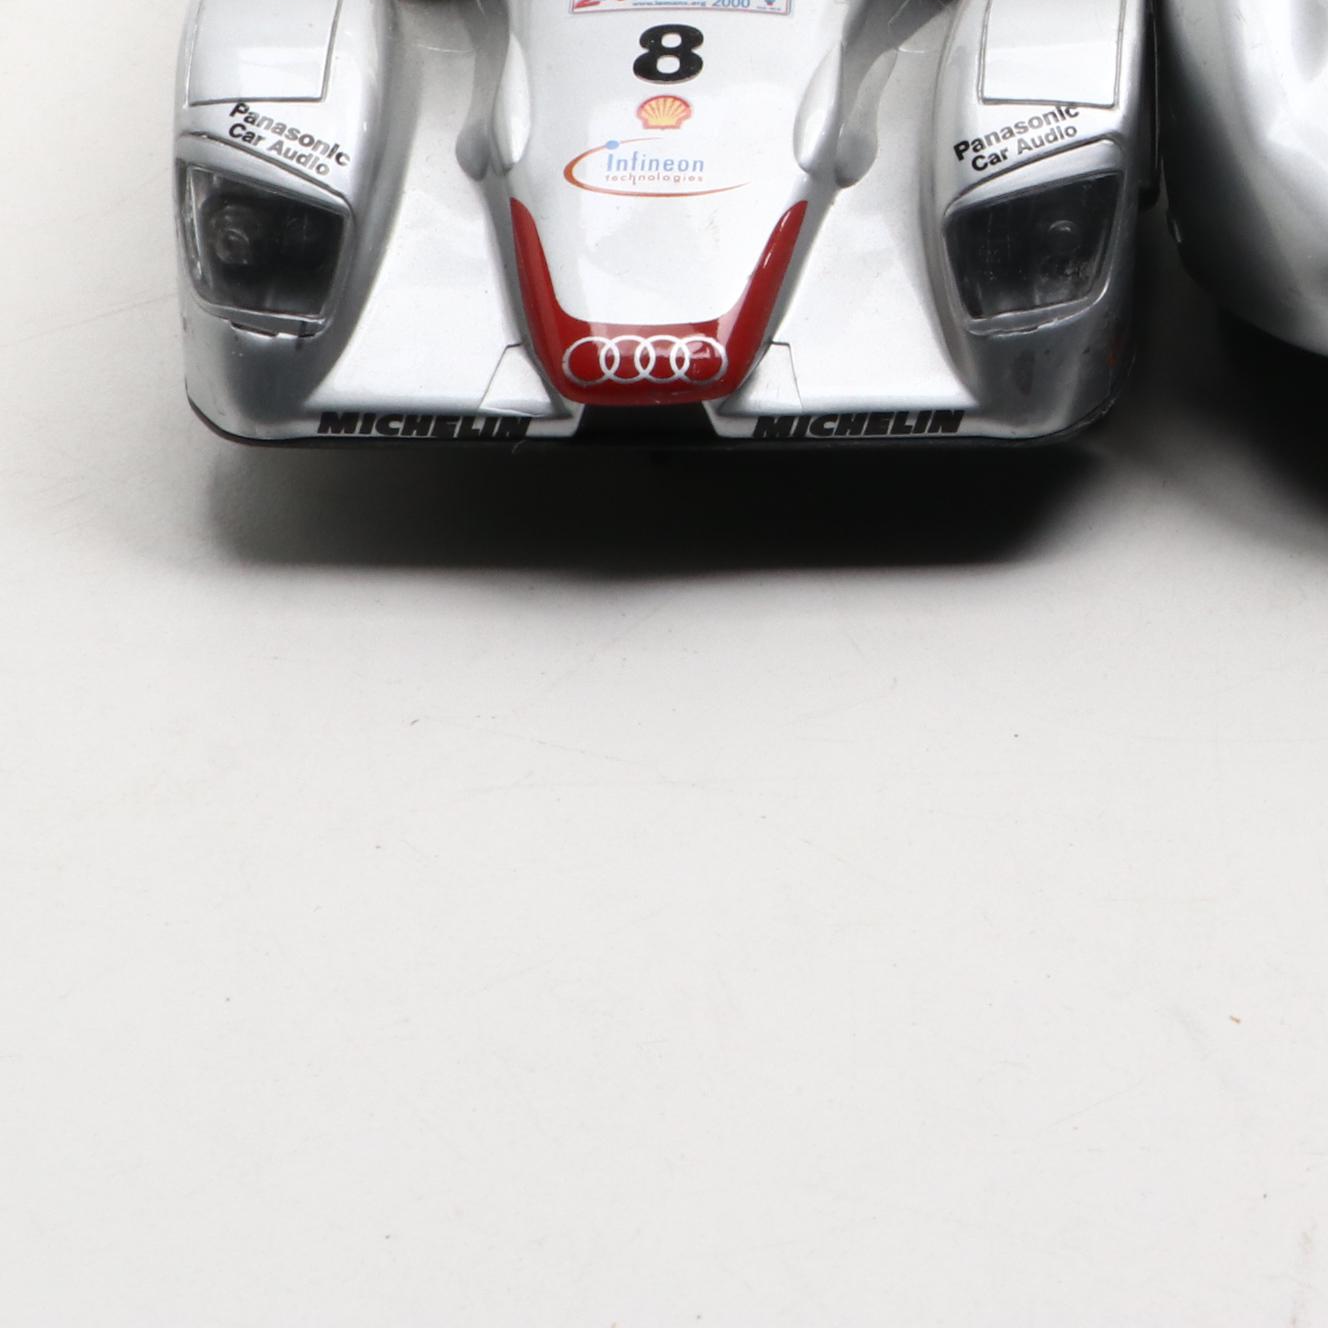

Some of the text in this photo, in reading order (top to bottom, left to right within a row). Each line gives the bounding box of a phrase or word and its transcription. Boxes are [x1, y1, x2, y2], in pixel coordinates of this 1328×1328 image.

[632, 23, 704, 84] 8
[228, 102, 351, 166] Panasonic
[228, 123, 330, 176] Car Audio
[953, 104, 1080, 161] Panasonic
[971, 125, 1078, 171] Car Audio
[605, 172, 703, 185] technologies
[317, 411, 533, 439] MICHELIN
[752, 409, 965, 439] MICHELIN
